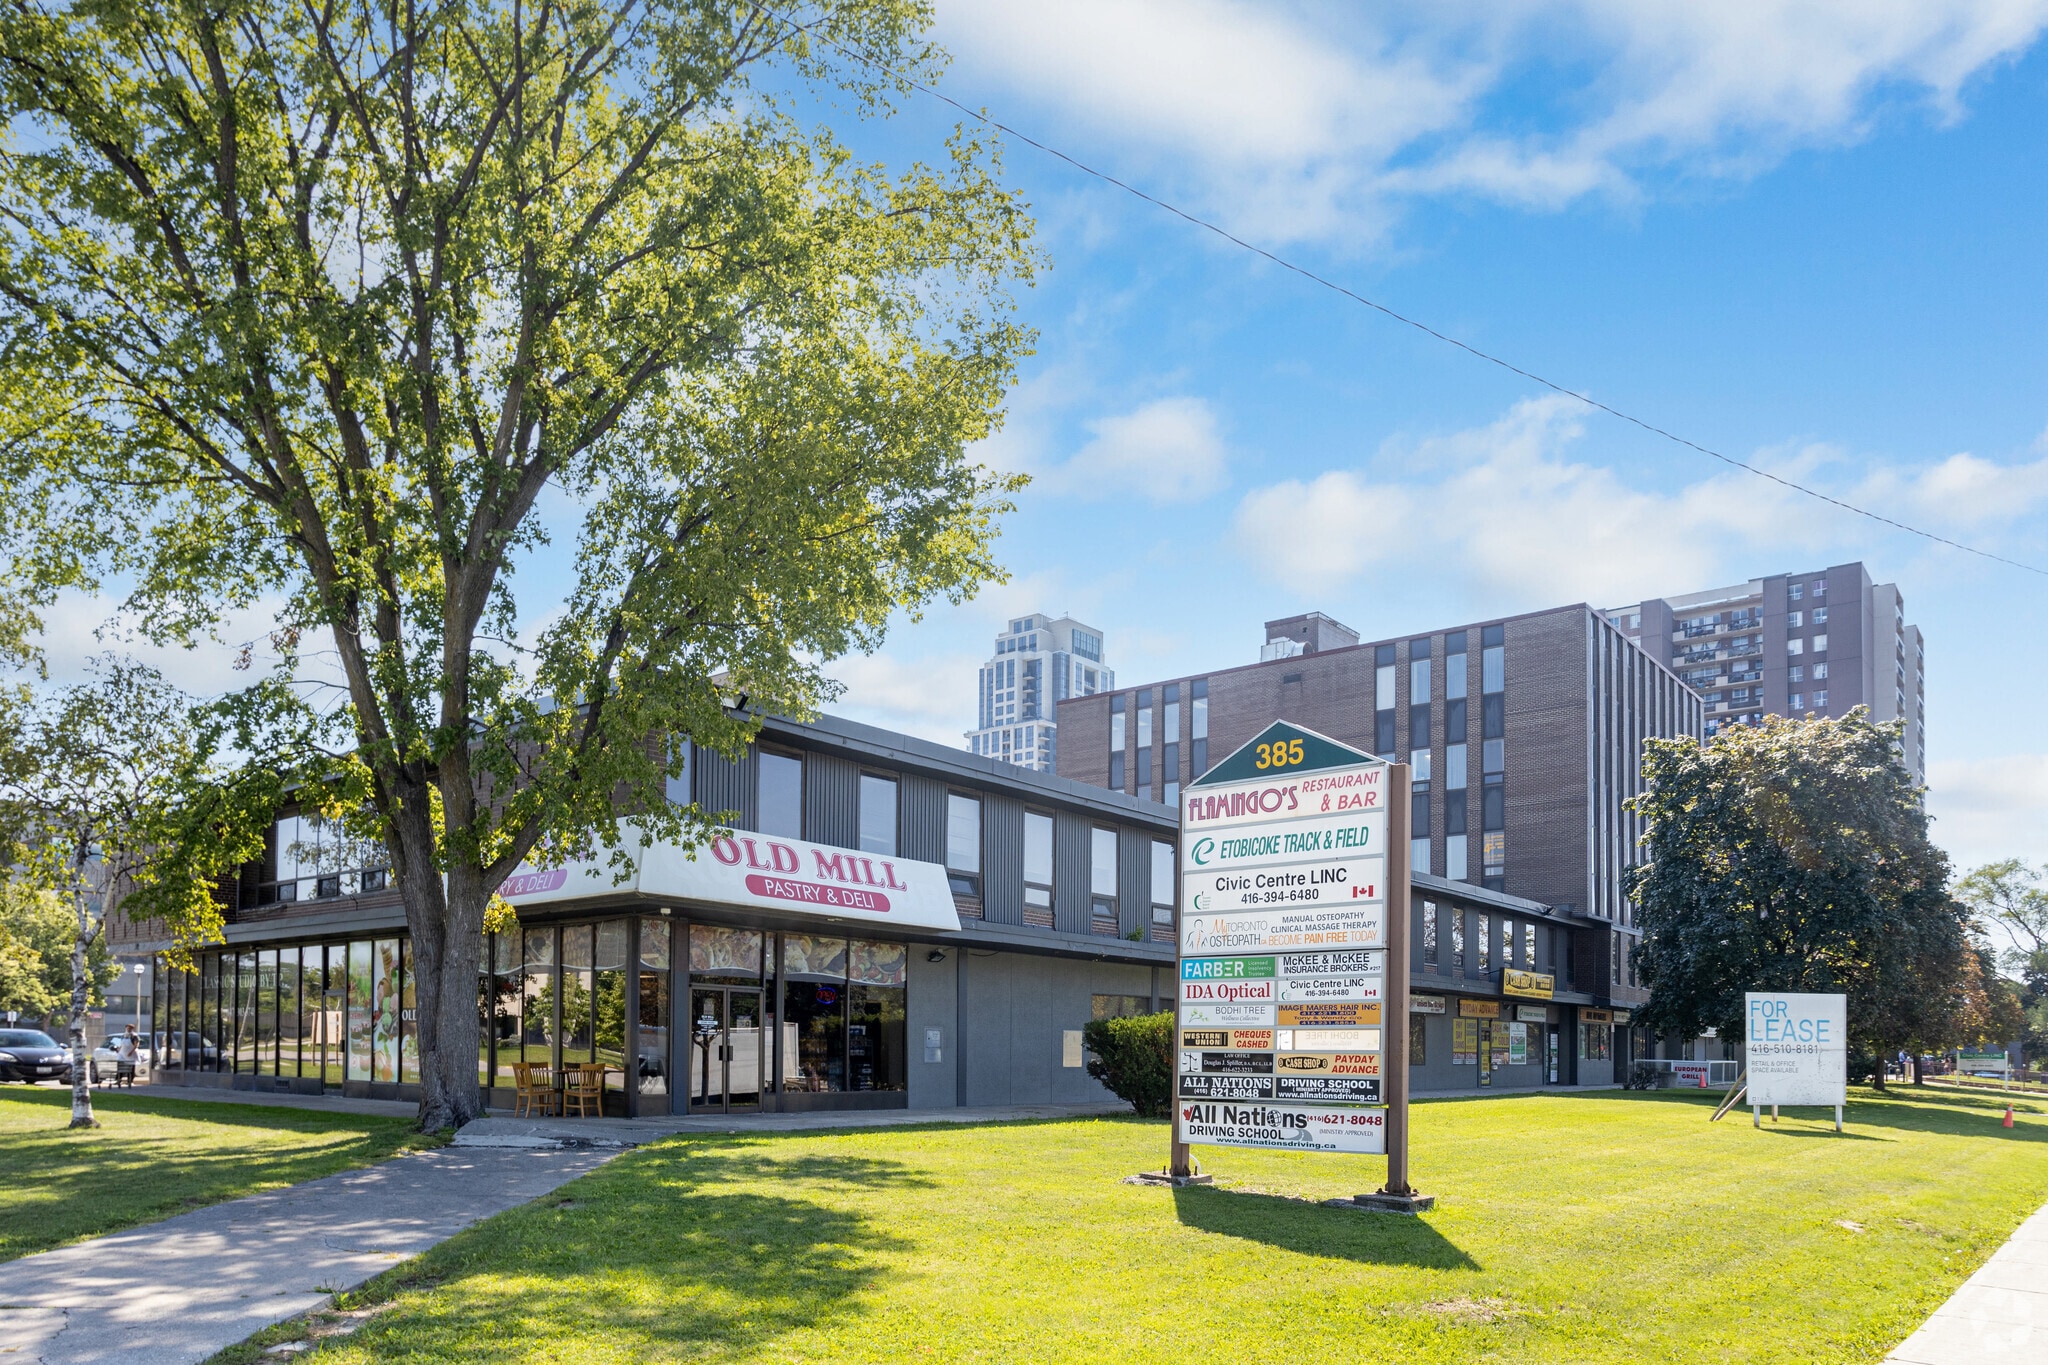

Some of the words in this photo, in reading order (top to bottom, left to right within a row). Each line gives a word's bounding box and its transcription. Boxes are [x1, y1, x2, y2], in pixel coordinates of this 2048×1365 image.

[1255, 738, 1304, 769] 385
[1301, 771, 1380, 792] RESTAURANT
[1188, 785, 1298, 822] FLAMINGO'S
[1320, 793, 1330, 812] &
[1337, 791, 1377, 809] BAR
[1220, 835, 1280, 859] ETOBICOKE
[1284, 831, 1322, 854] TRACK
[1323, 830, 1332, 849] &
[1335, 826, 1369, 848] FIELD
[711, 834, 800, 874] OLD
[811, 849, 907, 892] MILL
[514, 878, 524, 893] &
[527, 873, 554, 891] DELI
[1215, 875, 1250, 891] Civic
[1255, 873, 1306, 888] Centre
[1311, 868, 1347, 885] LINC
[764, 879, 820, 901] PASTRY
[827, 888, 839, 904] &
[842, 890, 875, 909] DELI
[1241, 888, 1319, 904] 416-394-6480
[1282, 915, 1314, 923] MANUAL
[1316, 912, 1365, 921] OSTEOPATHY
[1270, 924, 1303, 933] CLINICAL
[1305, 922, 1340, 931] MASSAGE
[1342, 920, 1377, 929] THERAPY
[1268, 934, 1302, 946] BECOME
[1304, 933, 1323, 944] PAIN
[1326, 932, 1347, 942] FREE
[1350, 930, 1378, 942] TODAY
[1283, 955, 1319, 966] McKEE
[1322, 955, 1329, 964] &
[1332, 953, 1370, 964] McKEE
[1185, 961, 1244, 977] FARBER
[1284, 964, 1328, 974] INSURANCE
[1330, 963, 1369, 972] BROKERS
[1290, 980, 1311, 989] Civic
[1313, 979, 1341, 988] Centre
[1344, 978, 1364, 987] LINC
[1186, 984, 1214, 999] IDA
[1217, 982, 1271, 1002] Optical
[1305, 989, 1349, 997] 416-394-6480
[1215, 1006, 1241, 1015] BODHI
[1244, 1006, 1266, 1014] TREE
[1361, 1003, 1380, 1011] INC.
[1479, 1004, 1499, 1014] ADVANCE
[1750, 1000, 1788, 1018] FOR
[1234, 1030, 1271, 1039] CHEQUES
[1750, 1019, 1831, 1042] LEASE
[1236, 1040, 1268, 1048] CASHED
[1751, 1044, 1818, 1054] 416-510-8181
[1285, 1058, 1303, 1068] CASH
[1303, 1058, 1320, 1068] SHOP
[1335, 1055, 1375, 1063] PAYDAY
[1332, 1065, 1379, 1074] ADVANCE
[1183, 1077, 1209, 1088] ALL
[1211, 1077, 1271, 1089] NATIONS
[1281, 1079, 1325, 1087] DRIVING
[1328, 1080, 1373, 1089] SCHOOL
[1210, 1088, 1259, 1097] 621-8048
[1278, 1091, 1377, 1101] www.allnationsdriving.ca
[1191, 1104, 1216, 1124] All
[1223, 1106, 1307, 1129] Nations
[1189, 1125, 1235, 1137] DRIVING
[1238, 1127, 1284, 1140] SCHOOL
[1216, 1137, 1337, 1149] www.allnationsdriving.ca
